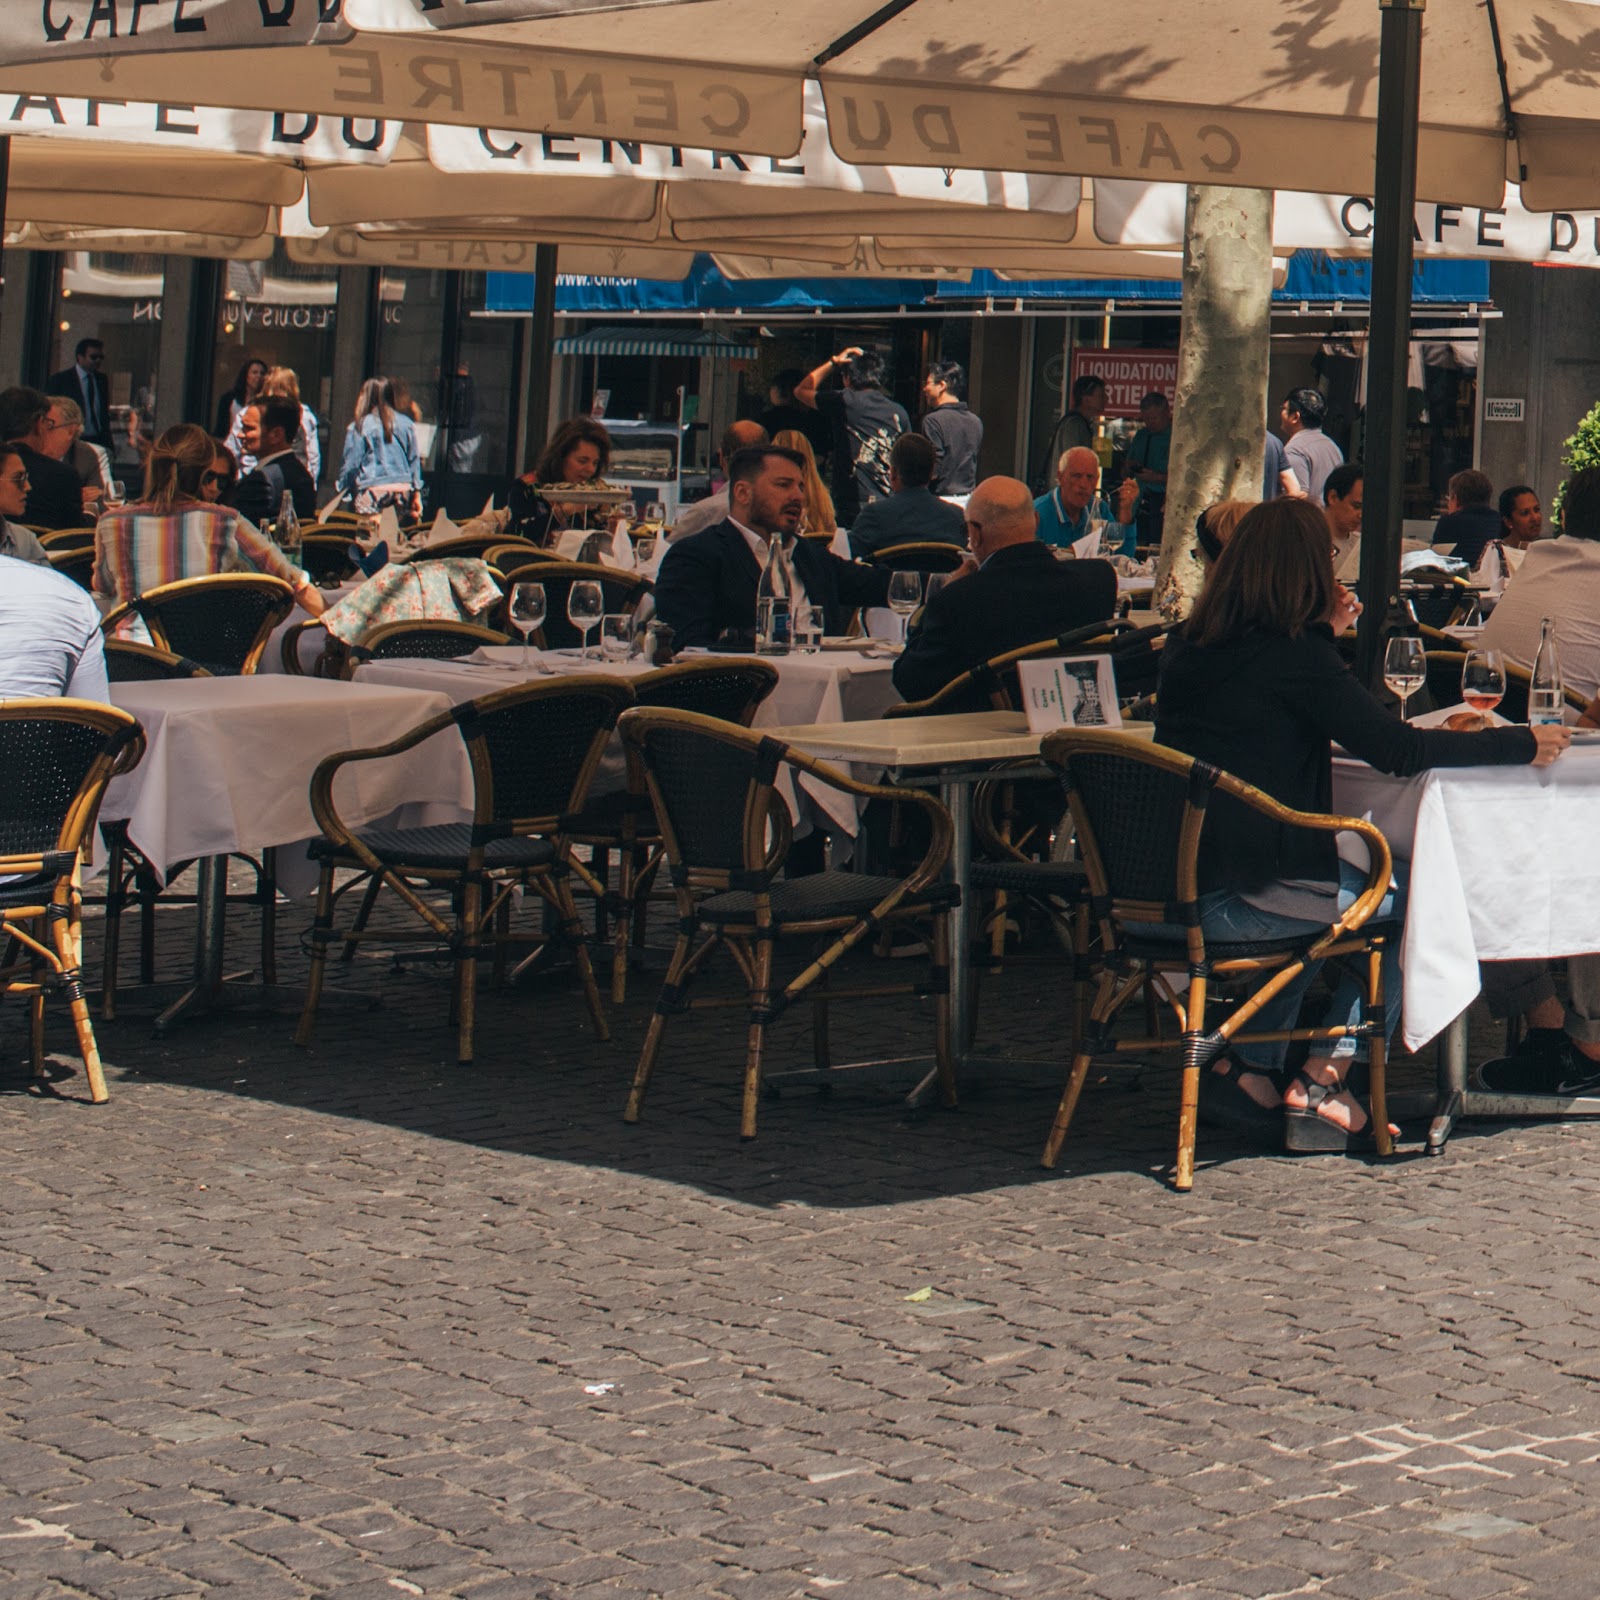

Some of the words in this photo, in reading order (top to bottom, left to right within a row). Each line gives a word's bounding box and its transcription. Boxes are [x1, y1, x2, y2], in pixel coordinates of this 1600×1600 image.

[9, 93, 200, 135] AFE
[272, 111, 386, 152] DU
[1340, 196, 1507, 249] CFE
[1079, 360, 1177, 381] LIQUIDATION
